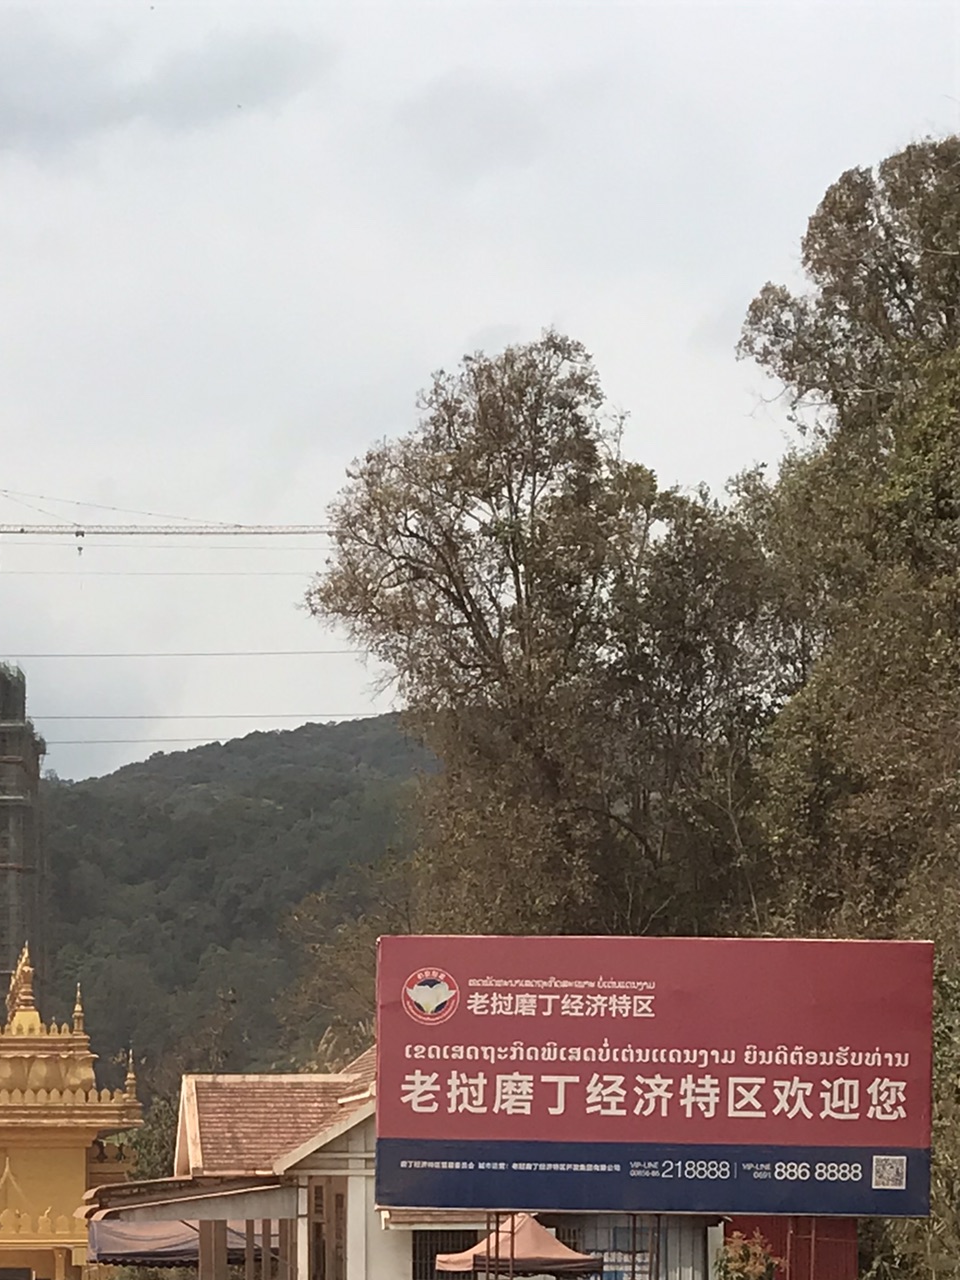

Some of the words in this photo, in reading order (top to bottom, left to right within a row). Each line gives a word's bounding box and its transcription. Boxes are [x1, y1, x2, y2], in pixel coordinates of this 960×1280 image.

[467, 992, 656, 1018] 老挝磨丁经济特区
[400, 1069, 907, 1121] 老挝磨丁经济特区欢迎您
[630, 1161, 659, 1169] VIP-LINE
[661, 1160, 731, 1179] 218888
[774, 1162, 810, 1181] 886
[814, 1163, 862, 1182] 8888
